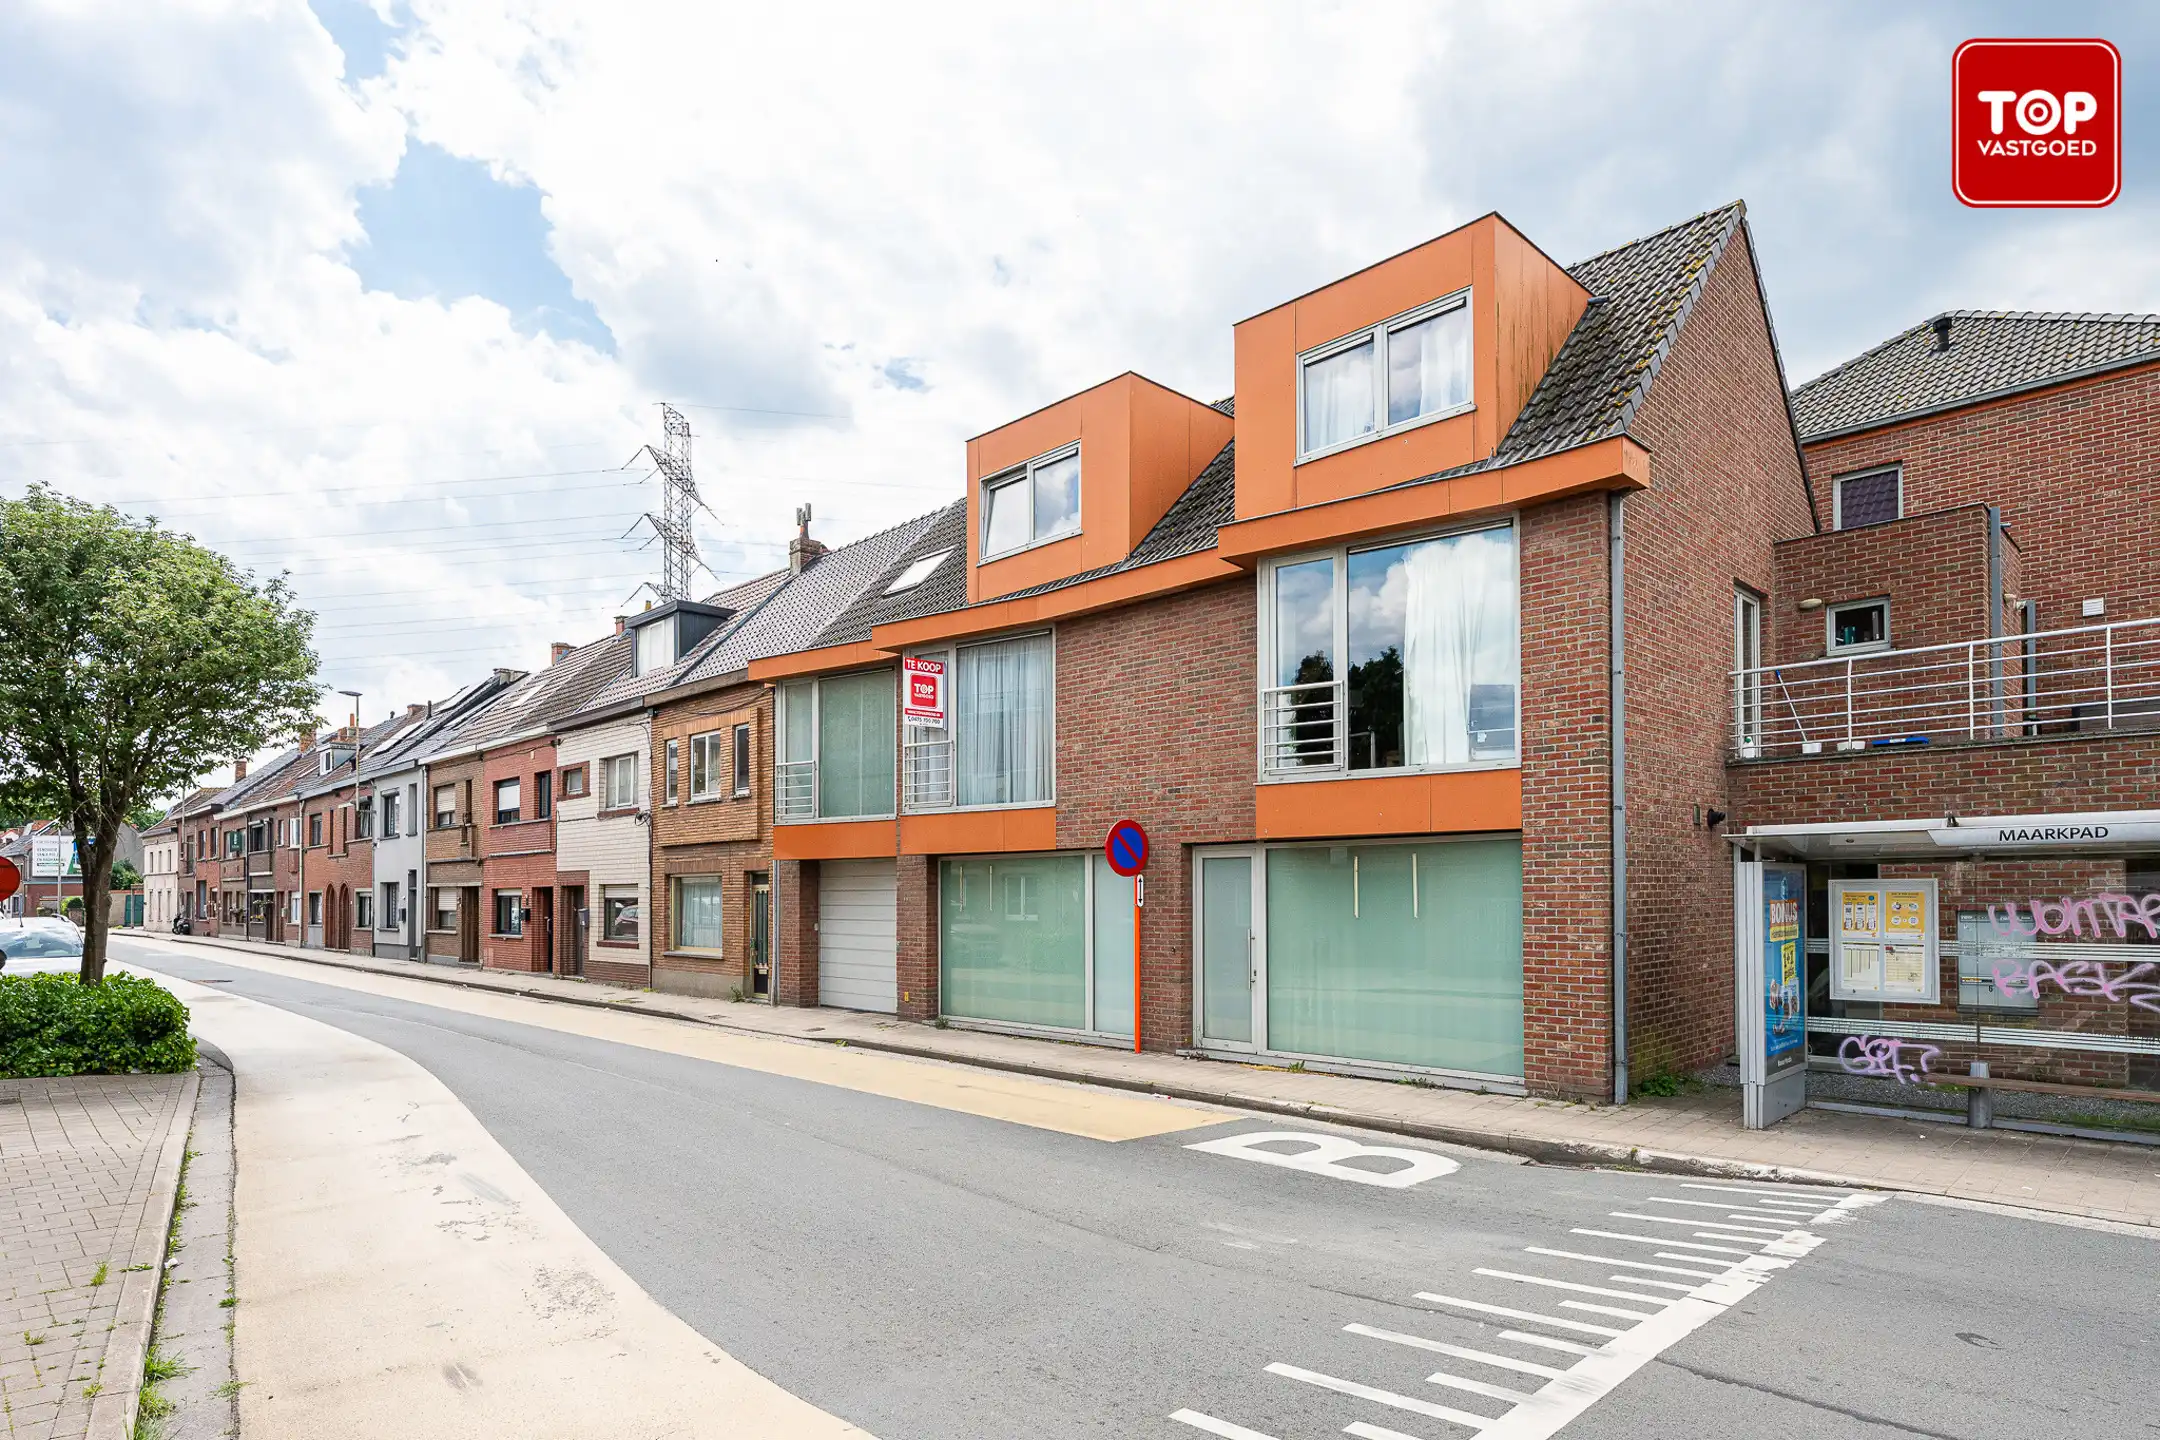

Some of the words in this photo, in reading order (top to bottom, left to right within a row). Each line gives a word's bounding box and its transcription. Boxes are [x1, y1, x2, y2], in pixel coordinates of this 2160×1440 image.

[906, 659, 916, 670] TE
[918, 661, 942, 673] KOOP
[914, 683, 934, 695] TOP
[1998, 826, 2109, 842] MAARKPAD
[1771, 902, 1798, 924] BONUS
[1181, 1131, 1462, 1189] B
